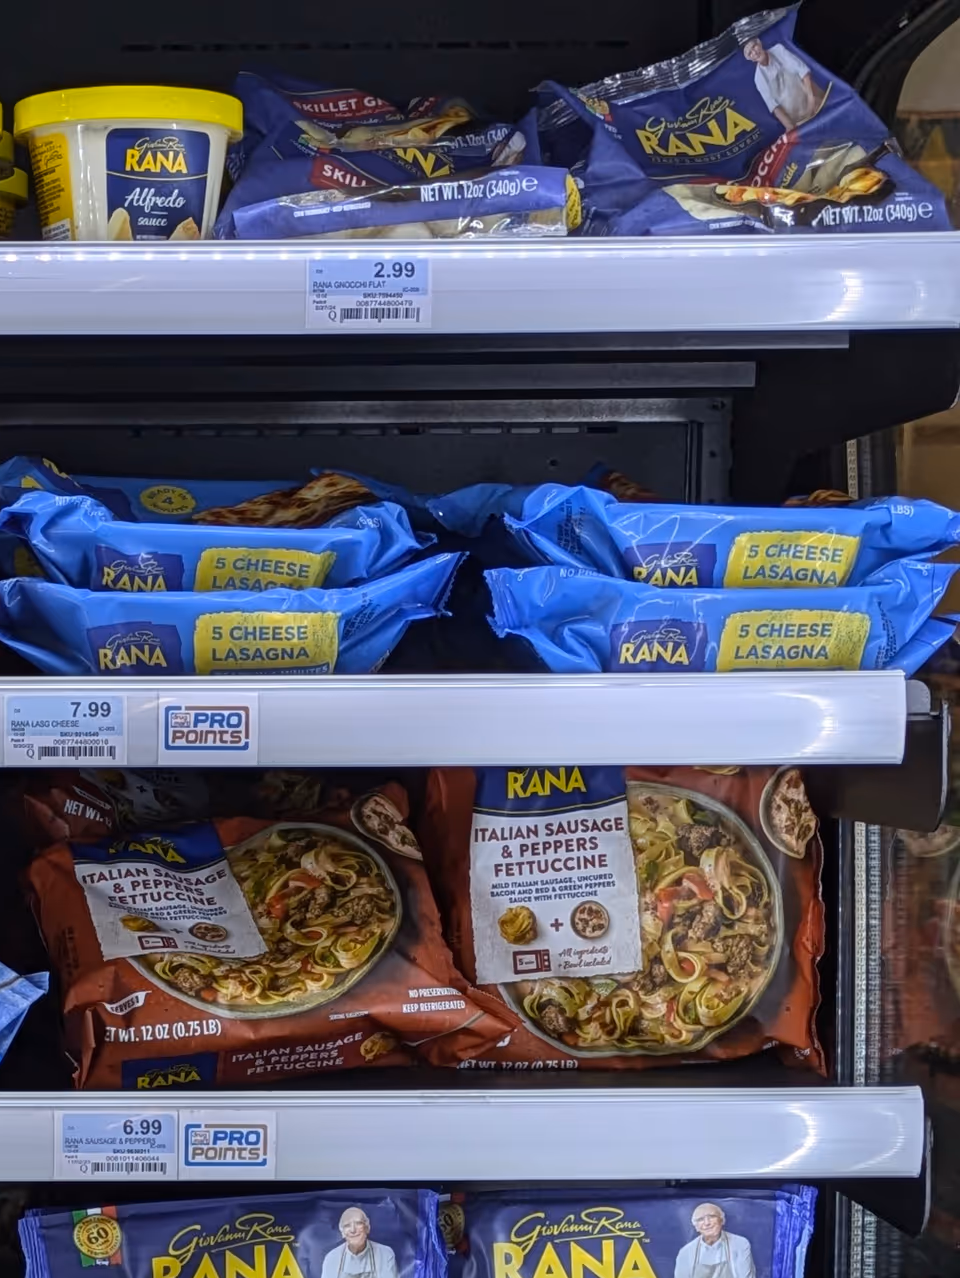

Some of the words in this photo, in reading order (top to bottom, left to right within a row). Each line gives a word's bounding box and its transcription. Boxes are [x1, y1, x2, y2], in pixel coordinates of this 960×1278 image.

[636, 107, 756, 158] RANA
[125, 149, 187, 173] RANA
[421, 186, 439, 202] NET
[441, 184, 461, 201] WT.
[463, 182, 484, 198] 12oz
[486, 179, 520, 198] (340g)
[374, 262, 415, 278] 2.99
[212, 627, 222, 641] 5
[229, 625, 307, 641] CHEESE
[98, 645, 167, 670] RANA
[211, 646, 309, 661] LASAGNA
[619, 642, 689, 665] RANA
[70, 702, 111, 718] 7.99
[193, 712, 242, 728] PRO
[172, 729, 242, 744] POINTS
[507, 767, 586, 798] RANA
[474, 825, 539, 842] ITALIAN
[544, 818, 624, 836] SAUSAGE
[502, 845, 513, 857] &
[519, 837, 598, 856] PEPPERS
[494, 855, 608, 877] FETTUCCINE
[123, 1120, 162, 1135] 6.99
